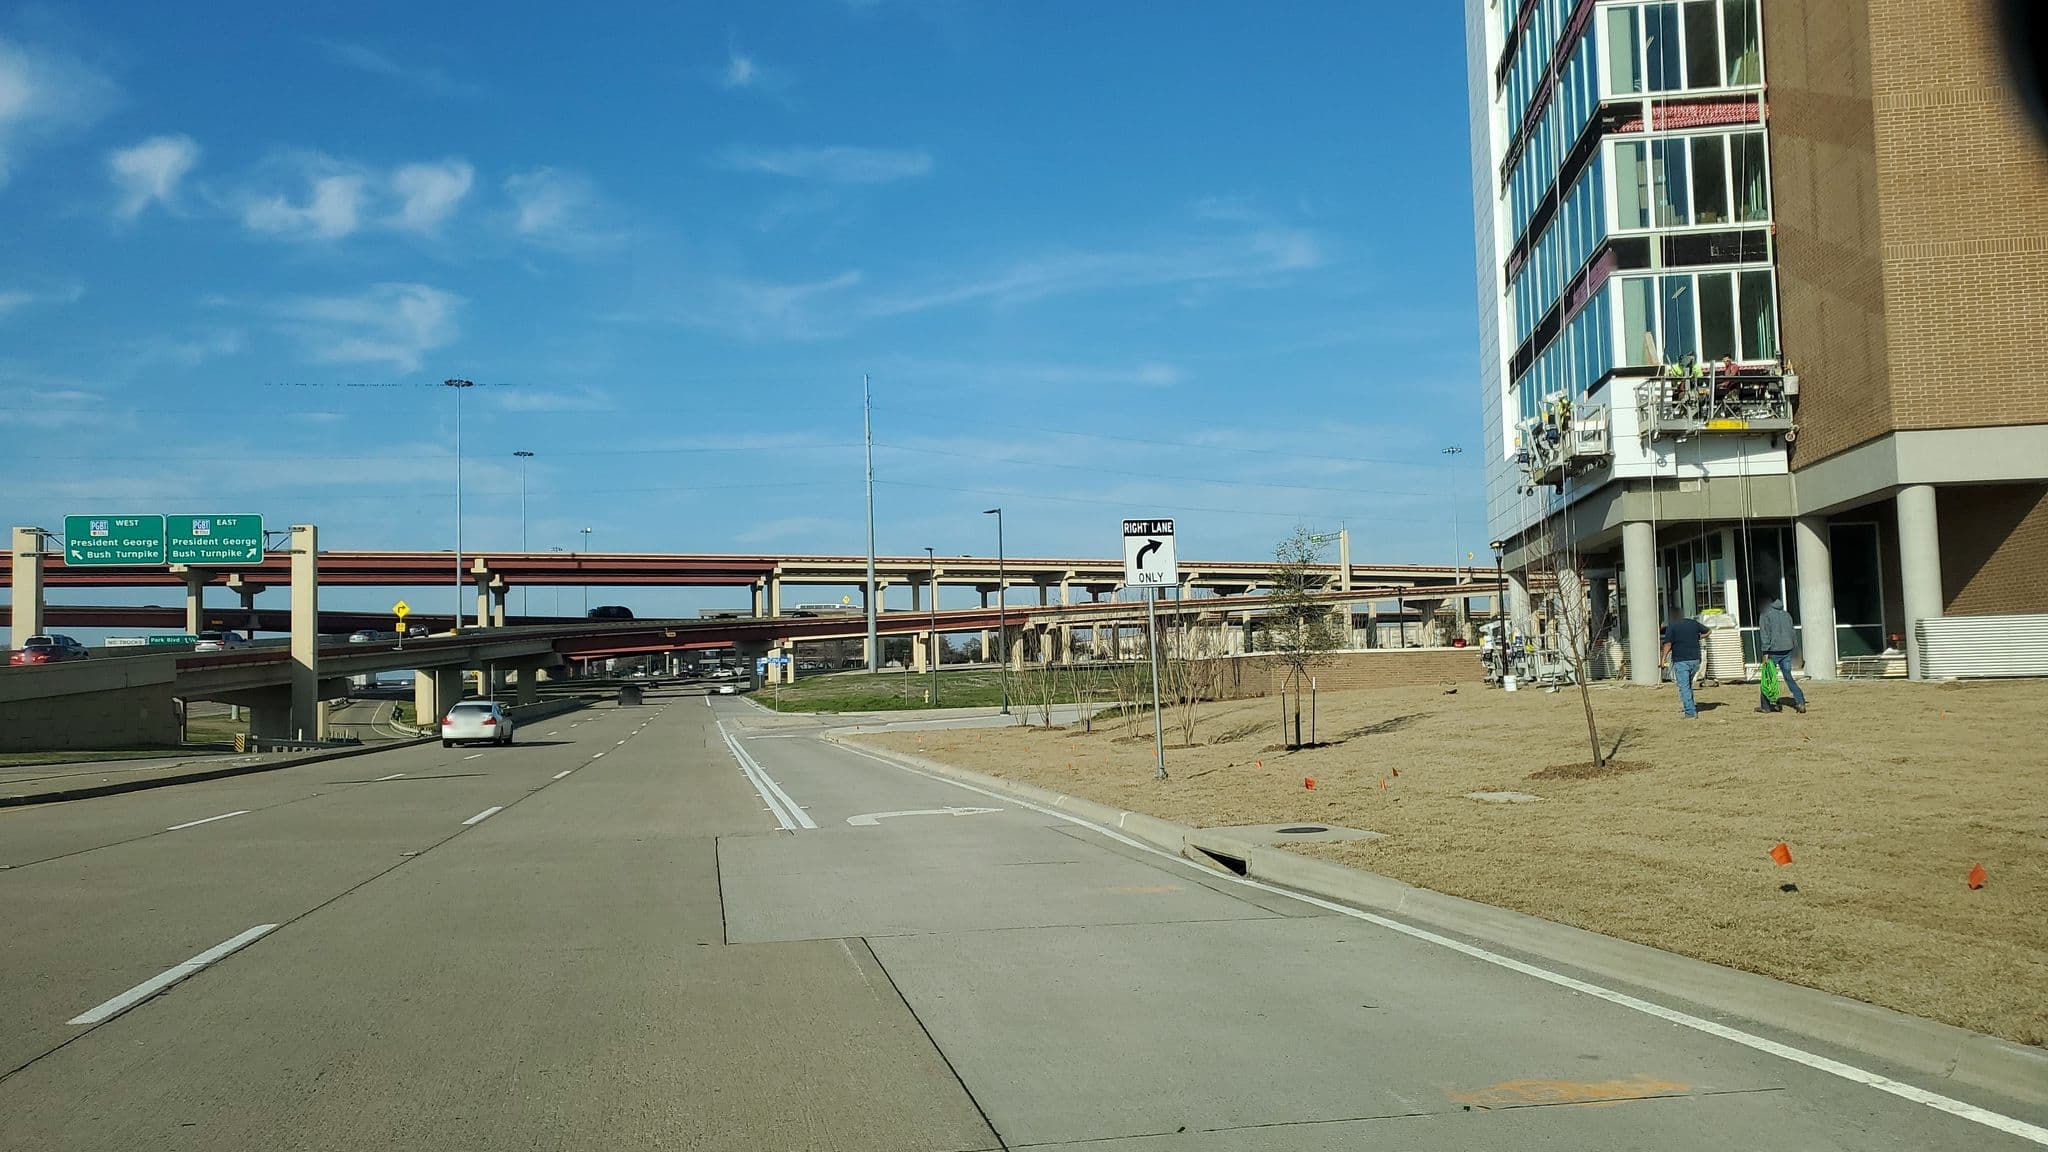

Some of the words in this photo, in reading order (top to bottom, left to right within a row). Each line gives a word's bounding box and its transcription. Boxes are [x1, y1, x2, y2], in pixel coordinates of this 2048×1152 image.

[115, 519, 139, 527] WEST
[1124, 522, 1148, 534] RIGHT
[1151, 521, 1173, 533] LANE
[70, 539, 118, 547] President
[123, 539, 159, 548] George
[172, 538, 219, 546] President
[222, 538, 257, 547] George
[87, 551, 111, 559] Bush
[115, 550, 159, 559] Turnpike
[172, 550, 196, 558] Bush
[200, 549, 242, 559] Turnpike
[1138, 572, 1164, 583] ONLY
